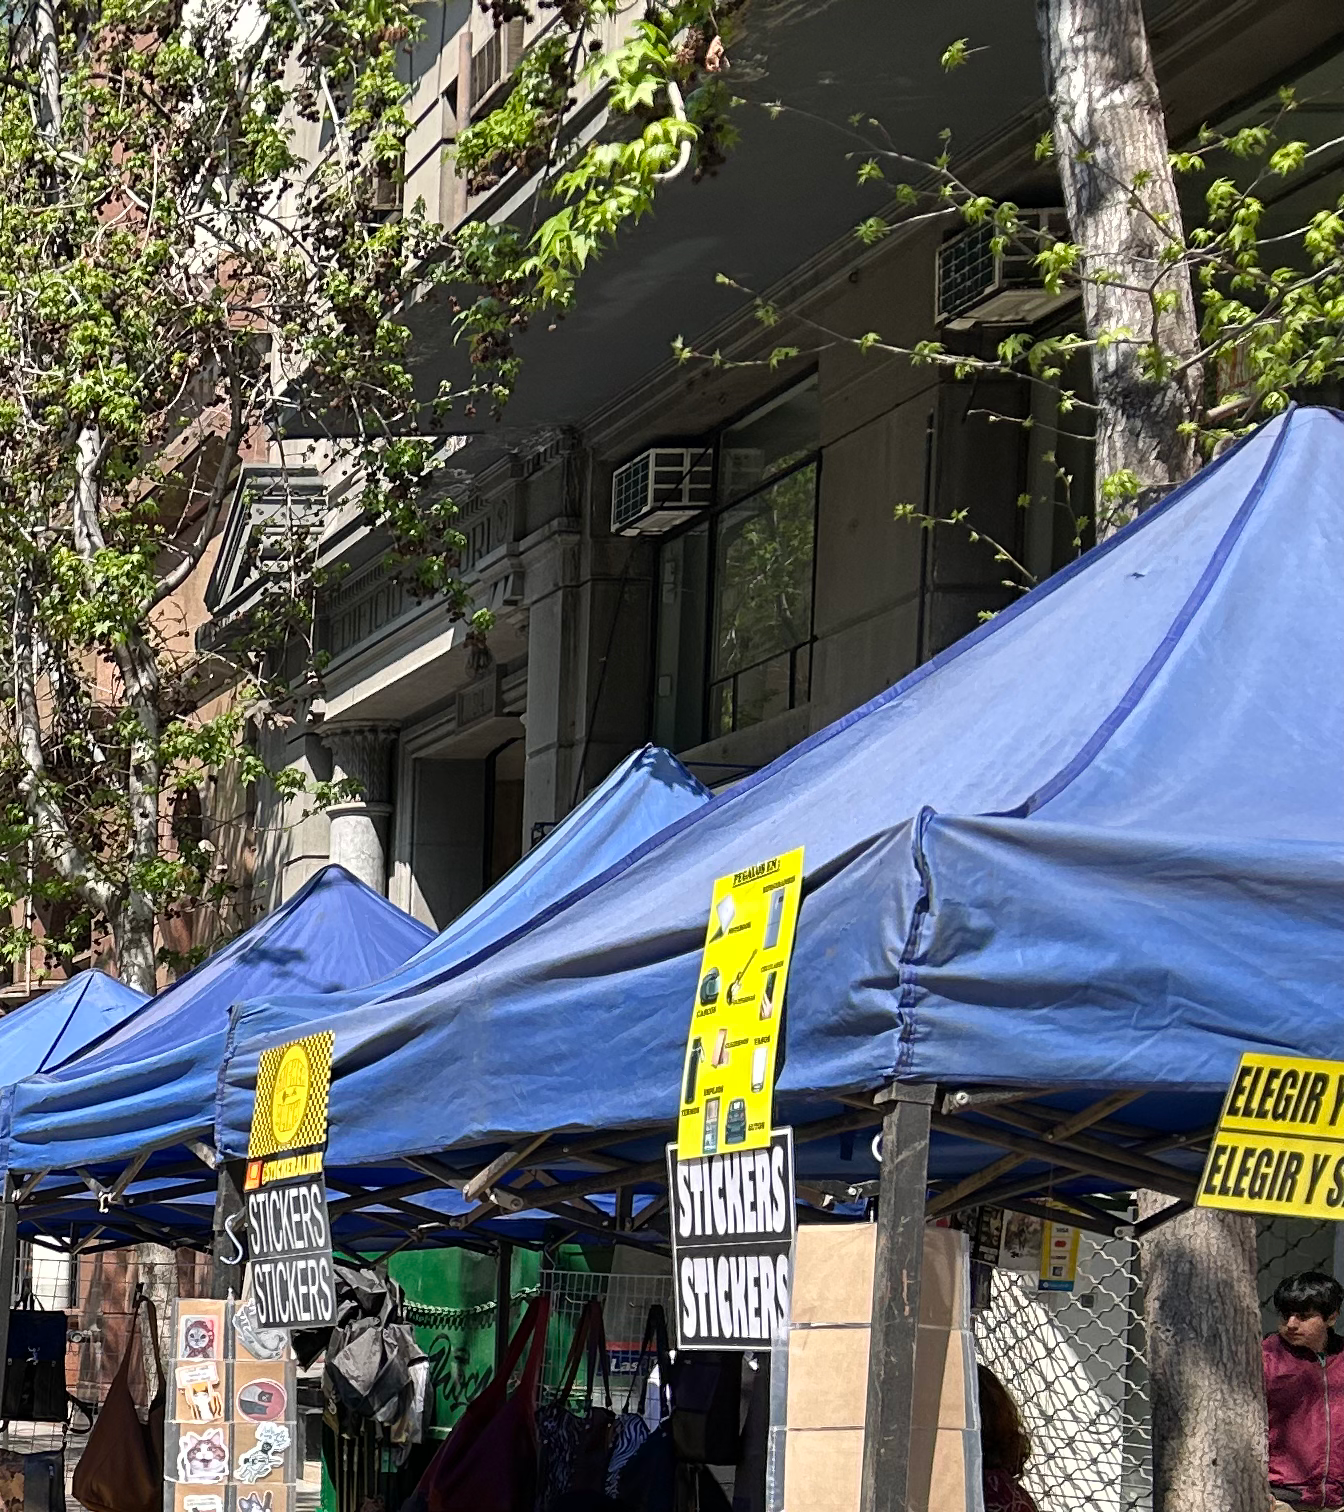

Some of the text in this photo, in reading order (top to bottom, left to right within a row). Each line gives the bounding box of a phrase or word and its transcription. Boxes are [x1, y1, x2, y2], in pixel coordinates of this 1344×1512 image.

[1227, 1065, 1329, 1126] ELEGIR
[677, 1156, 786, 1239] STICKERS
[1204, 1144, 1303, 1203] ELEGIR
[1304, 1153, 1331, 1204] Y
[248, 1183, 326, 1256] STICKERS
[254, 1258, 333, 1325] STICKERS
[680, 1252, 789, 1339] STICKERS
